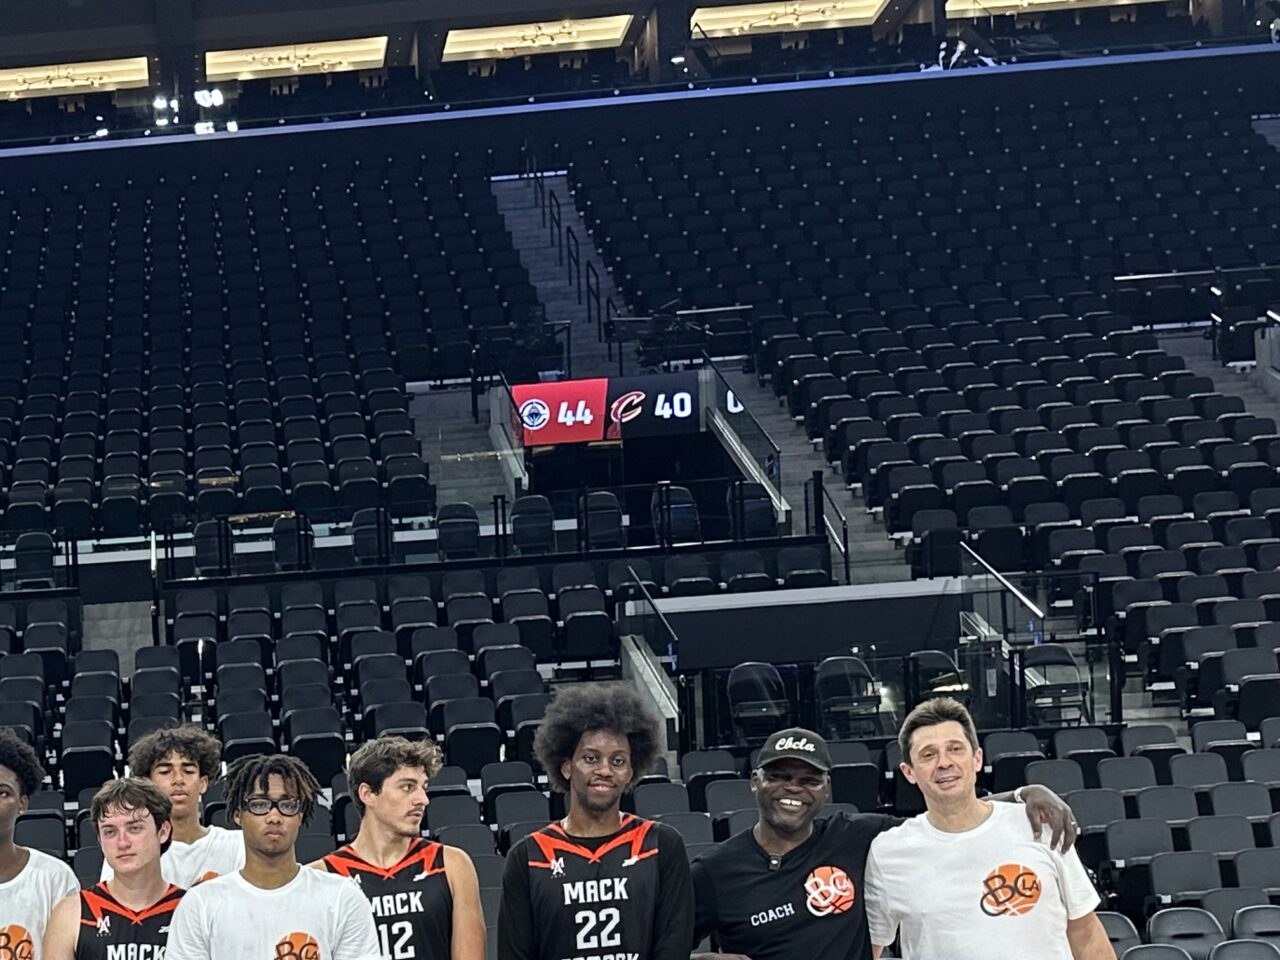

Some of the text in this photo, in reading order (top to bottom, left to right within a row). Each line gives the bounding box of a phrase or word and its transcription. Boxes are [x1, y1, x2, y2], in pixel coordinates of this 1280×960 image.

[557, 400, 594, 425] 44
[654, 392, 692, 419] 40
[562, 877, 629, 905] MACK
[575, 907, 621, 950] 22
[750, 903, 796, 927] COACH
[378, 921, 416, 960] 12
